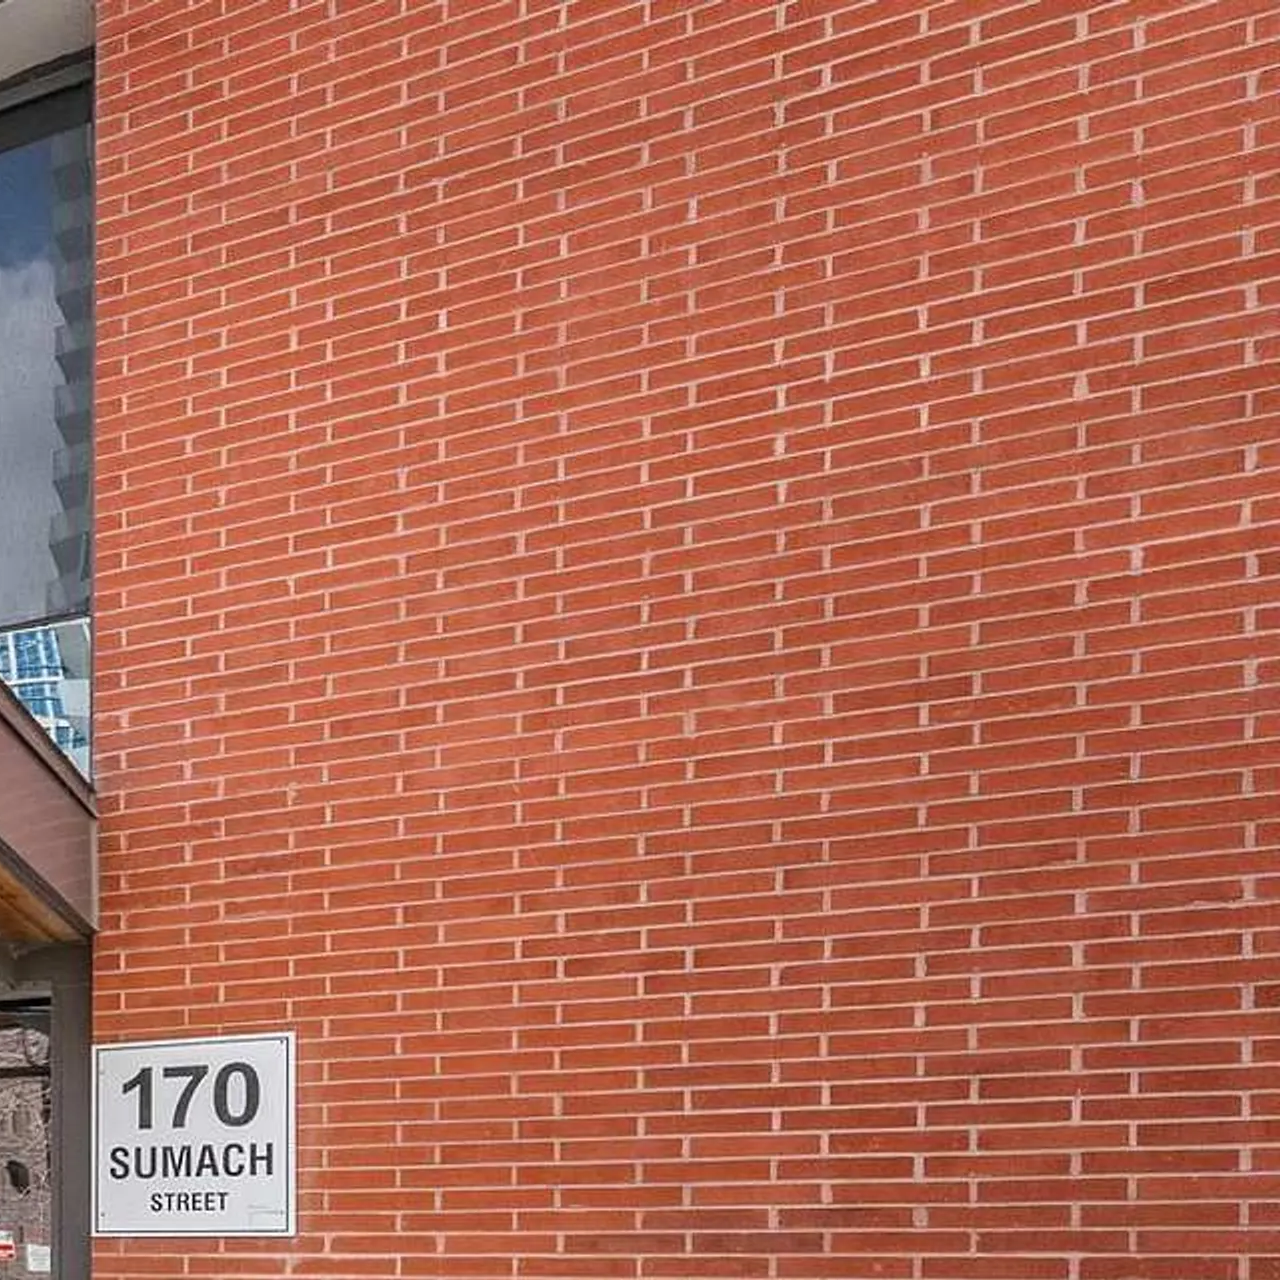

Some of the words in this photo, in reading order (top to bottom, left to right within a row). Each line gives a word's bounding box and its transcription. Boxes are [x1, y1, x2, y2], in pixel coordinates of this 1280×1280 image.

[121, 1062, 260, 1129] 170
[109, 1142, 274, 1180] SUMACH
[149, 1191, 229, 1213] STREET
